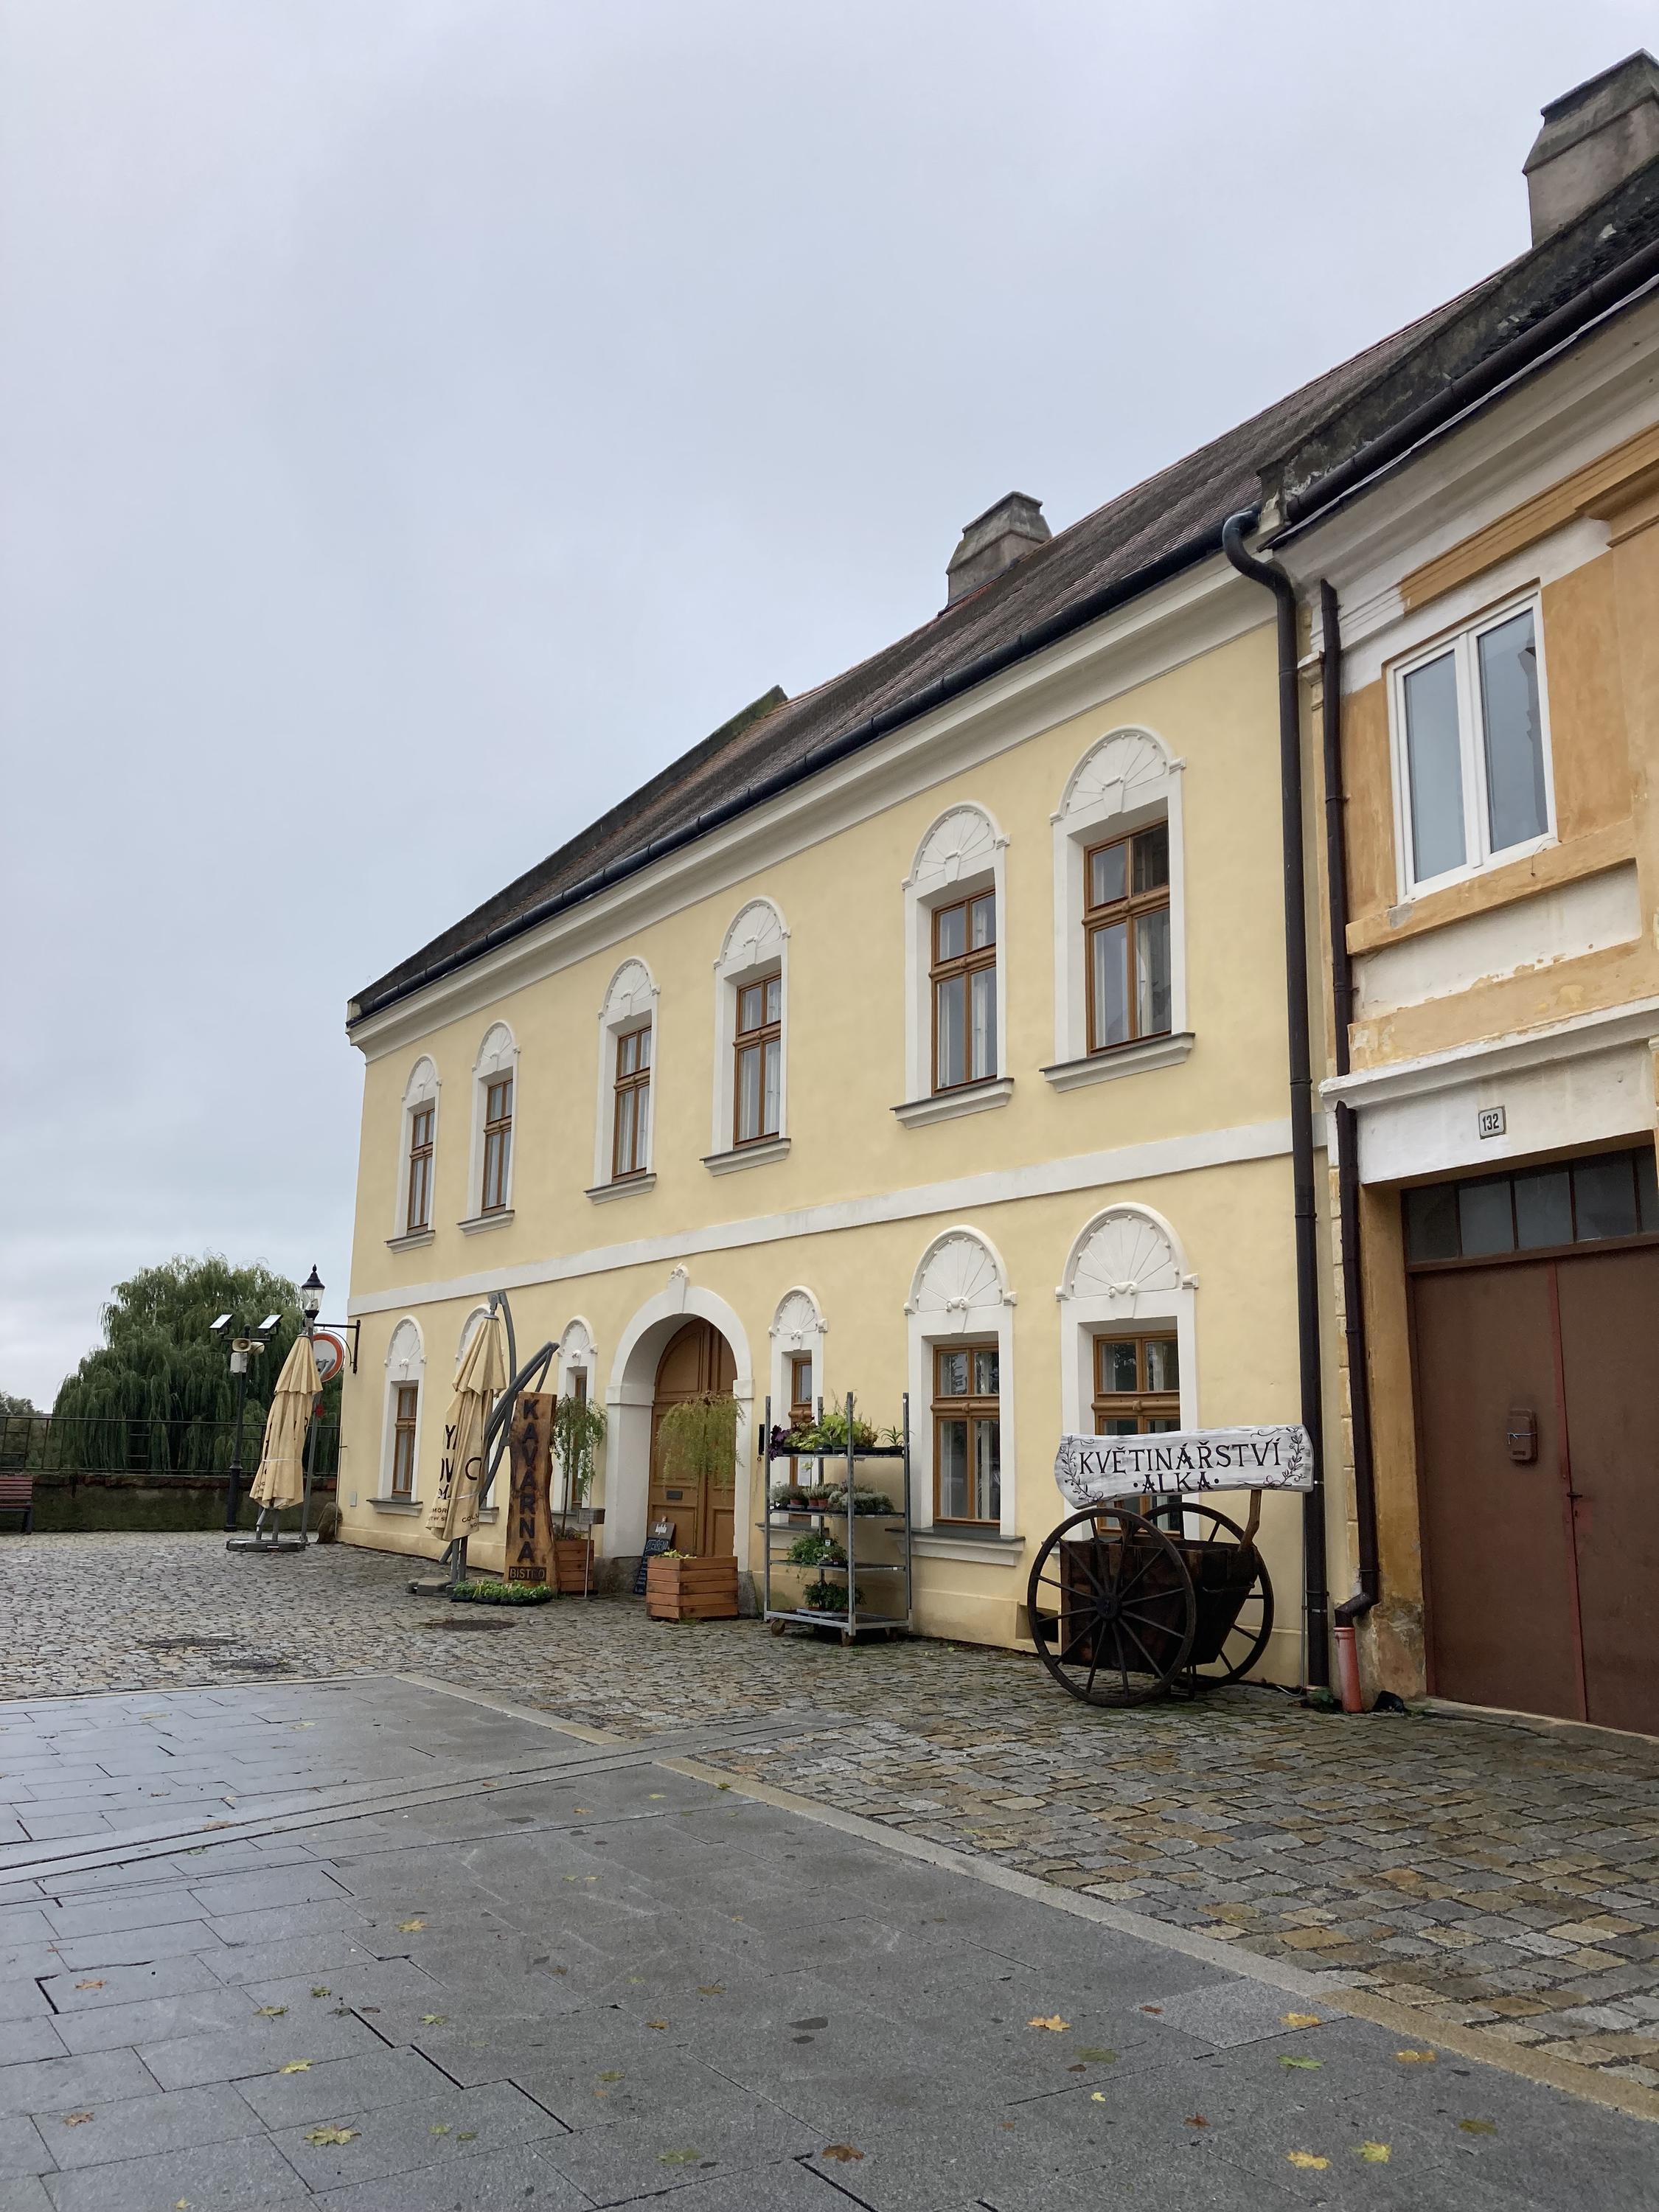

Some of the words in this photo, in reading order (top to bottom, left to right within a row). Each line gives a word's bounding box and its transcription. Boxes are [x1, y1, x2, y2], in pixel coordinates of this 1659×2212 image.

[1482, 1113, 1500, 1132] 132
[1079, 1437, 1281, 1475] KVĚTINÁŘSTVÍ
[1141, 1471, 1214, 1494] ALKA
